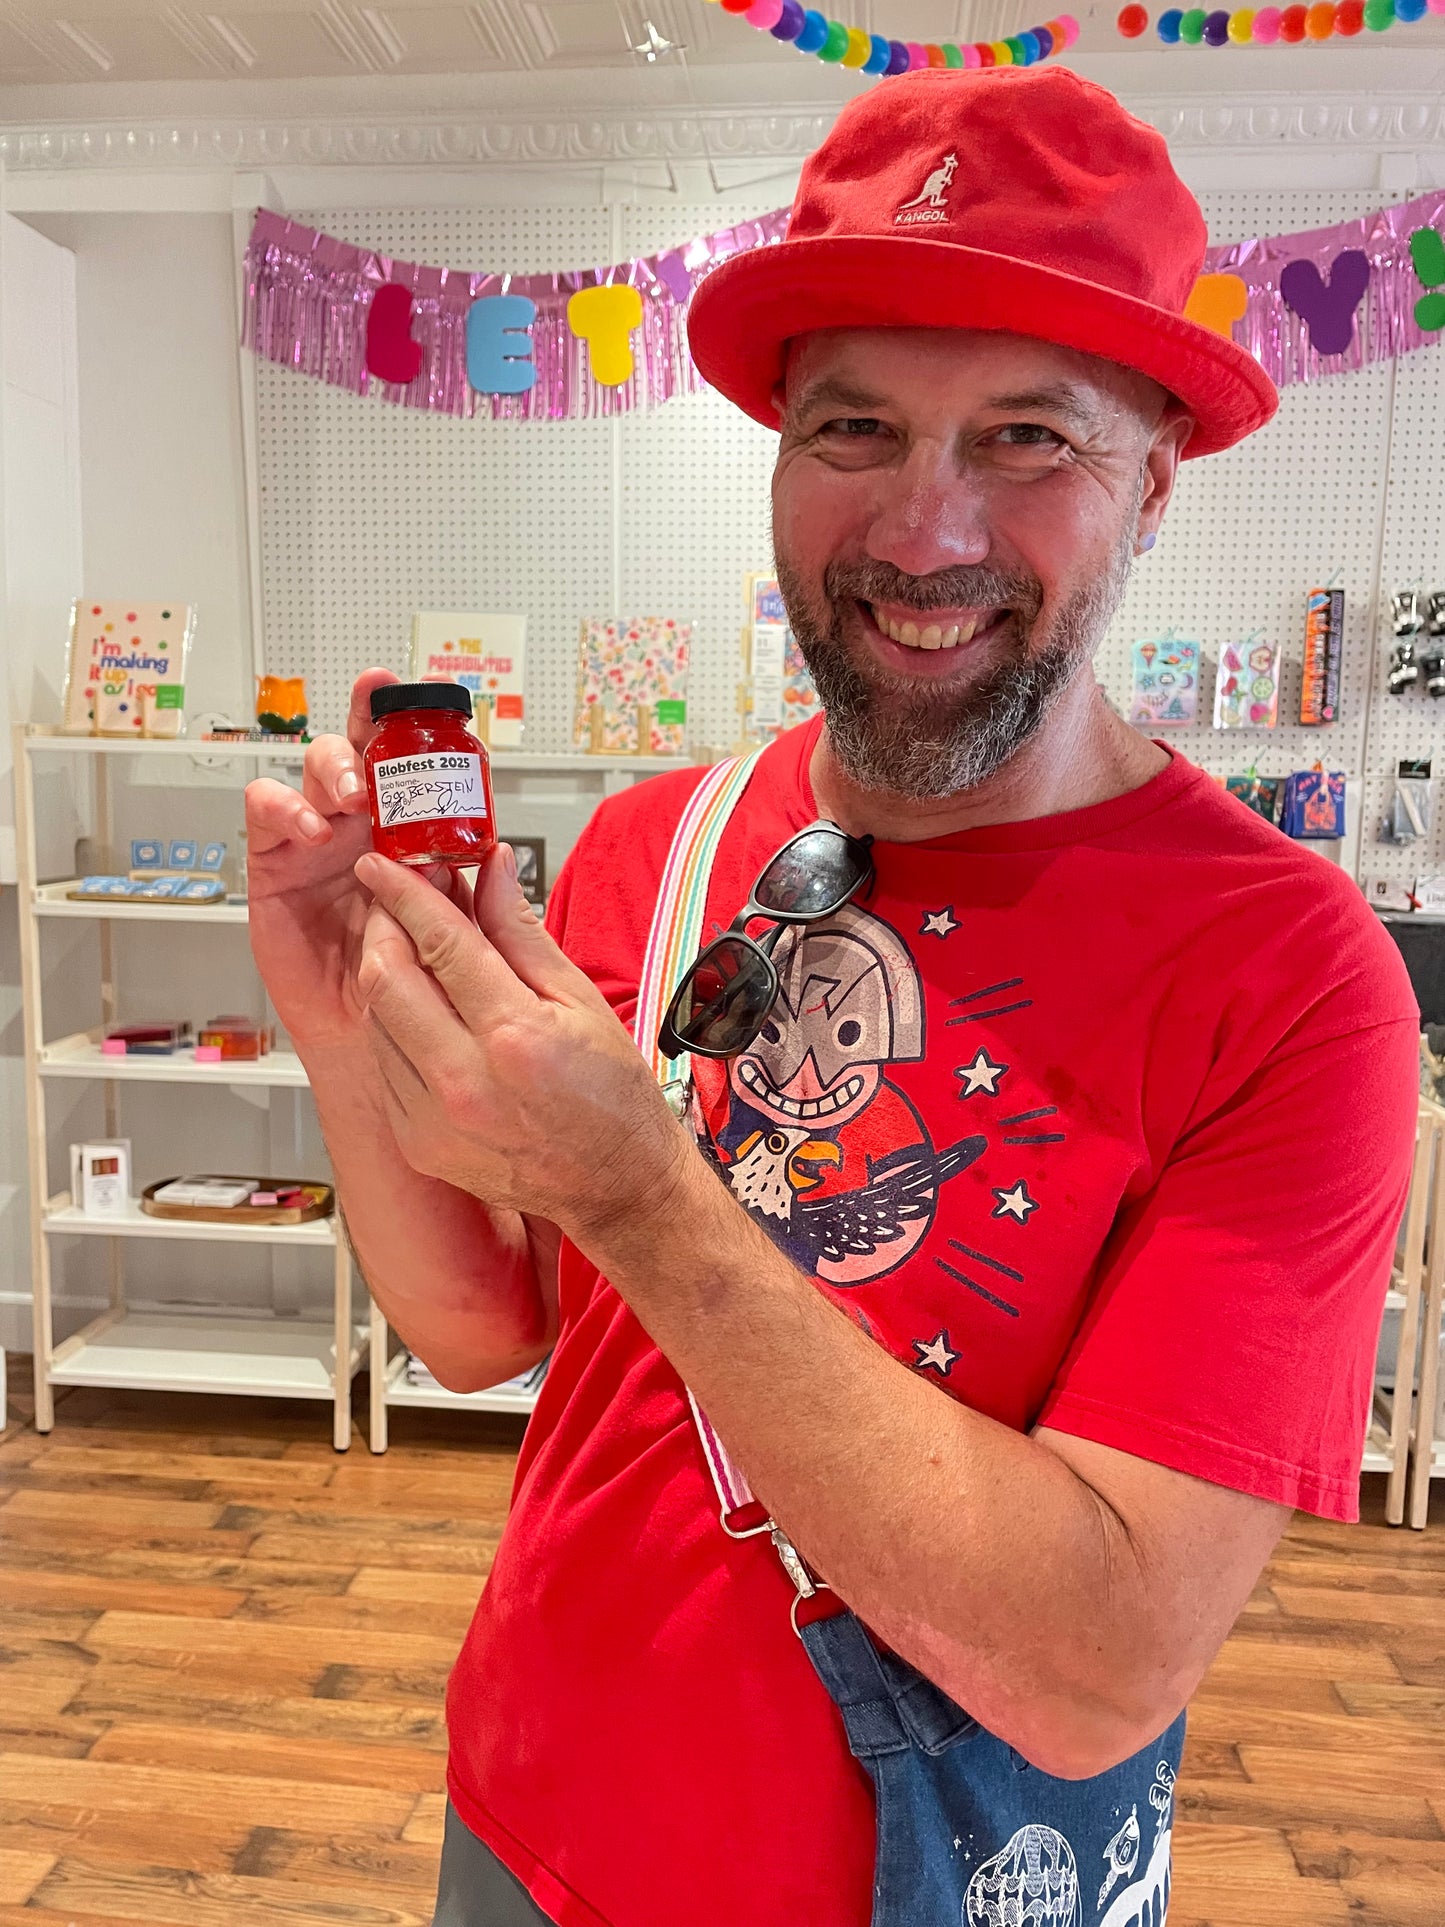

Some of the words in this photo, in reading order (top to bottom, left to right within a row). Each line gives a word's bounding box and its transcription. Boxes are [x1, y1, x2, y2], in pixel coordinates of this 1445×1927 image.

[895, 210, 950, 226] KANGOL
[459, 638, 481, 654] THE
[101, 652, 168, 674] making
[429, 655, 512, 674] POSSIBILITIES
[89, 663, 100, 681] it
[104, 670, 128, 685] up
[378, 758, 435, 778] Blobfest
[440, 756, 470, 769] 2025
[380, 782, 395, 792] Blob
